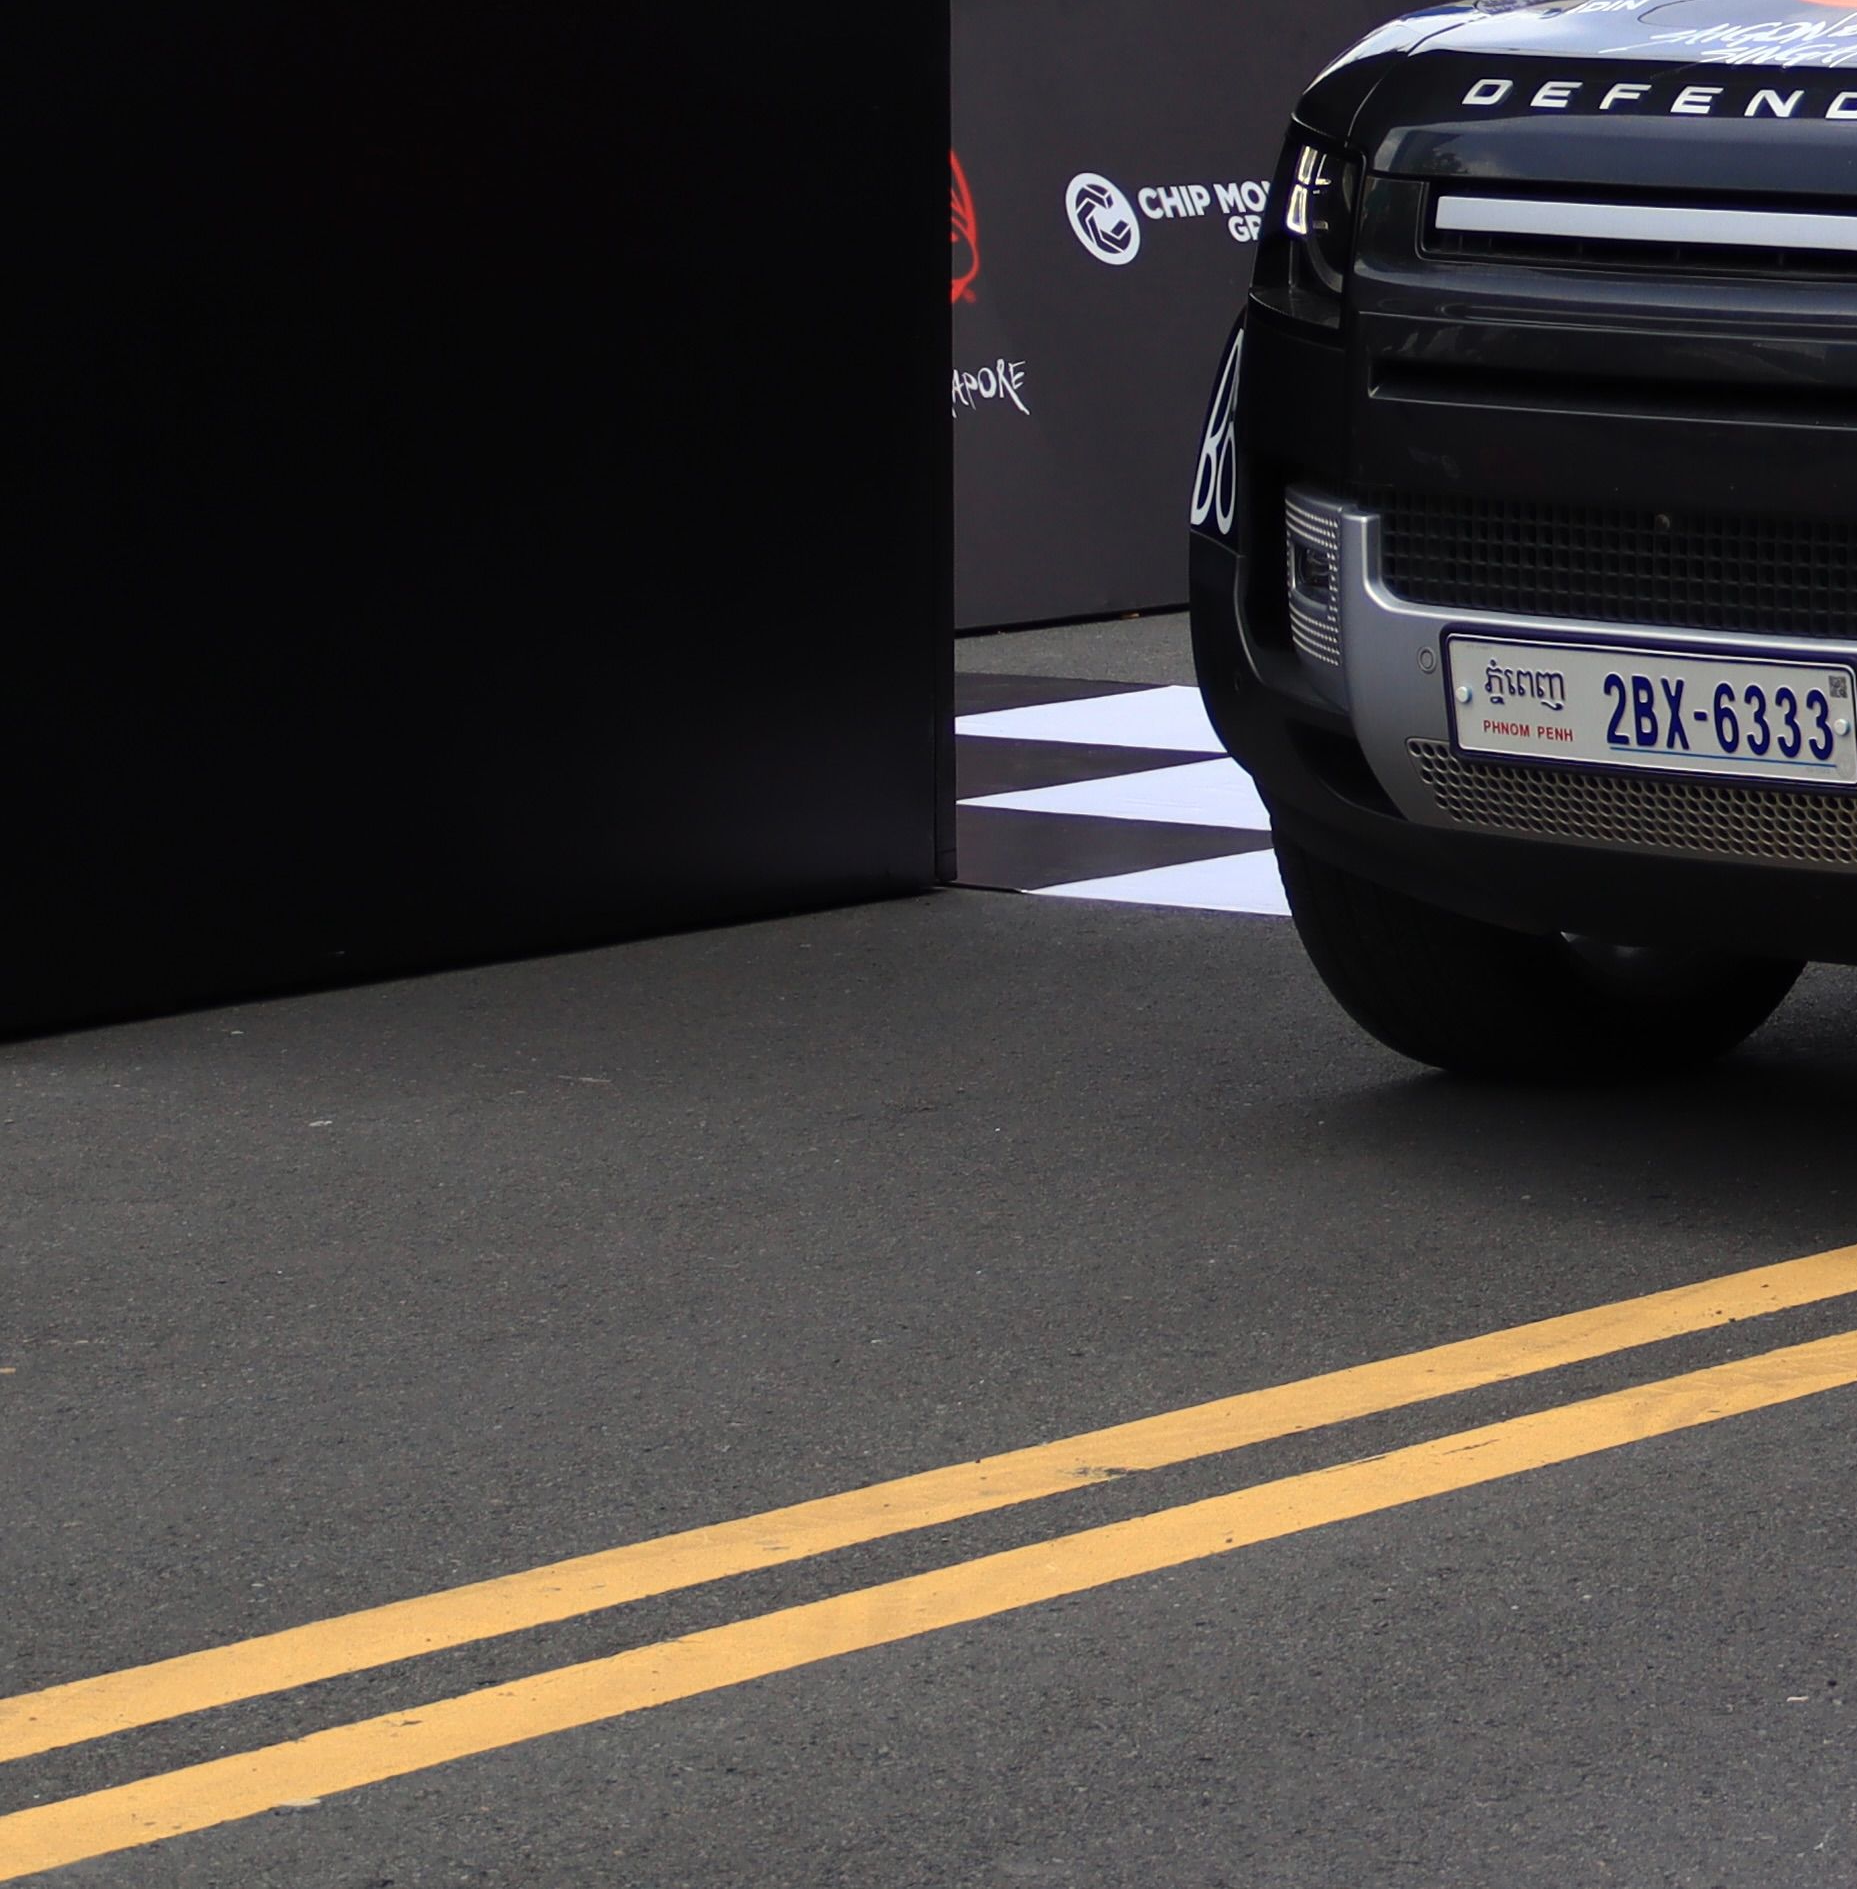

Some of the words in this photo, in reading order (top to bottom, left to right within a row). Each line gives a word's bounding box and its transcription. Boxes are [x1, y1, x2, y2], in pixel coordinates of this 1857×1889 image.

[1138, 184, 1211, 220] CHIP
[1483, 718, 1531, 738] PHNOM
[1537, 725, 1574, 743] PENH
[1603, 671, 1835, 762] 2BX-6333
